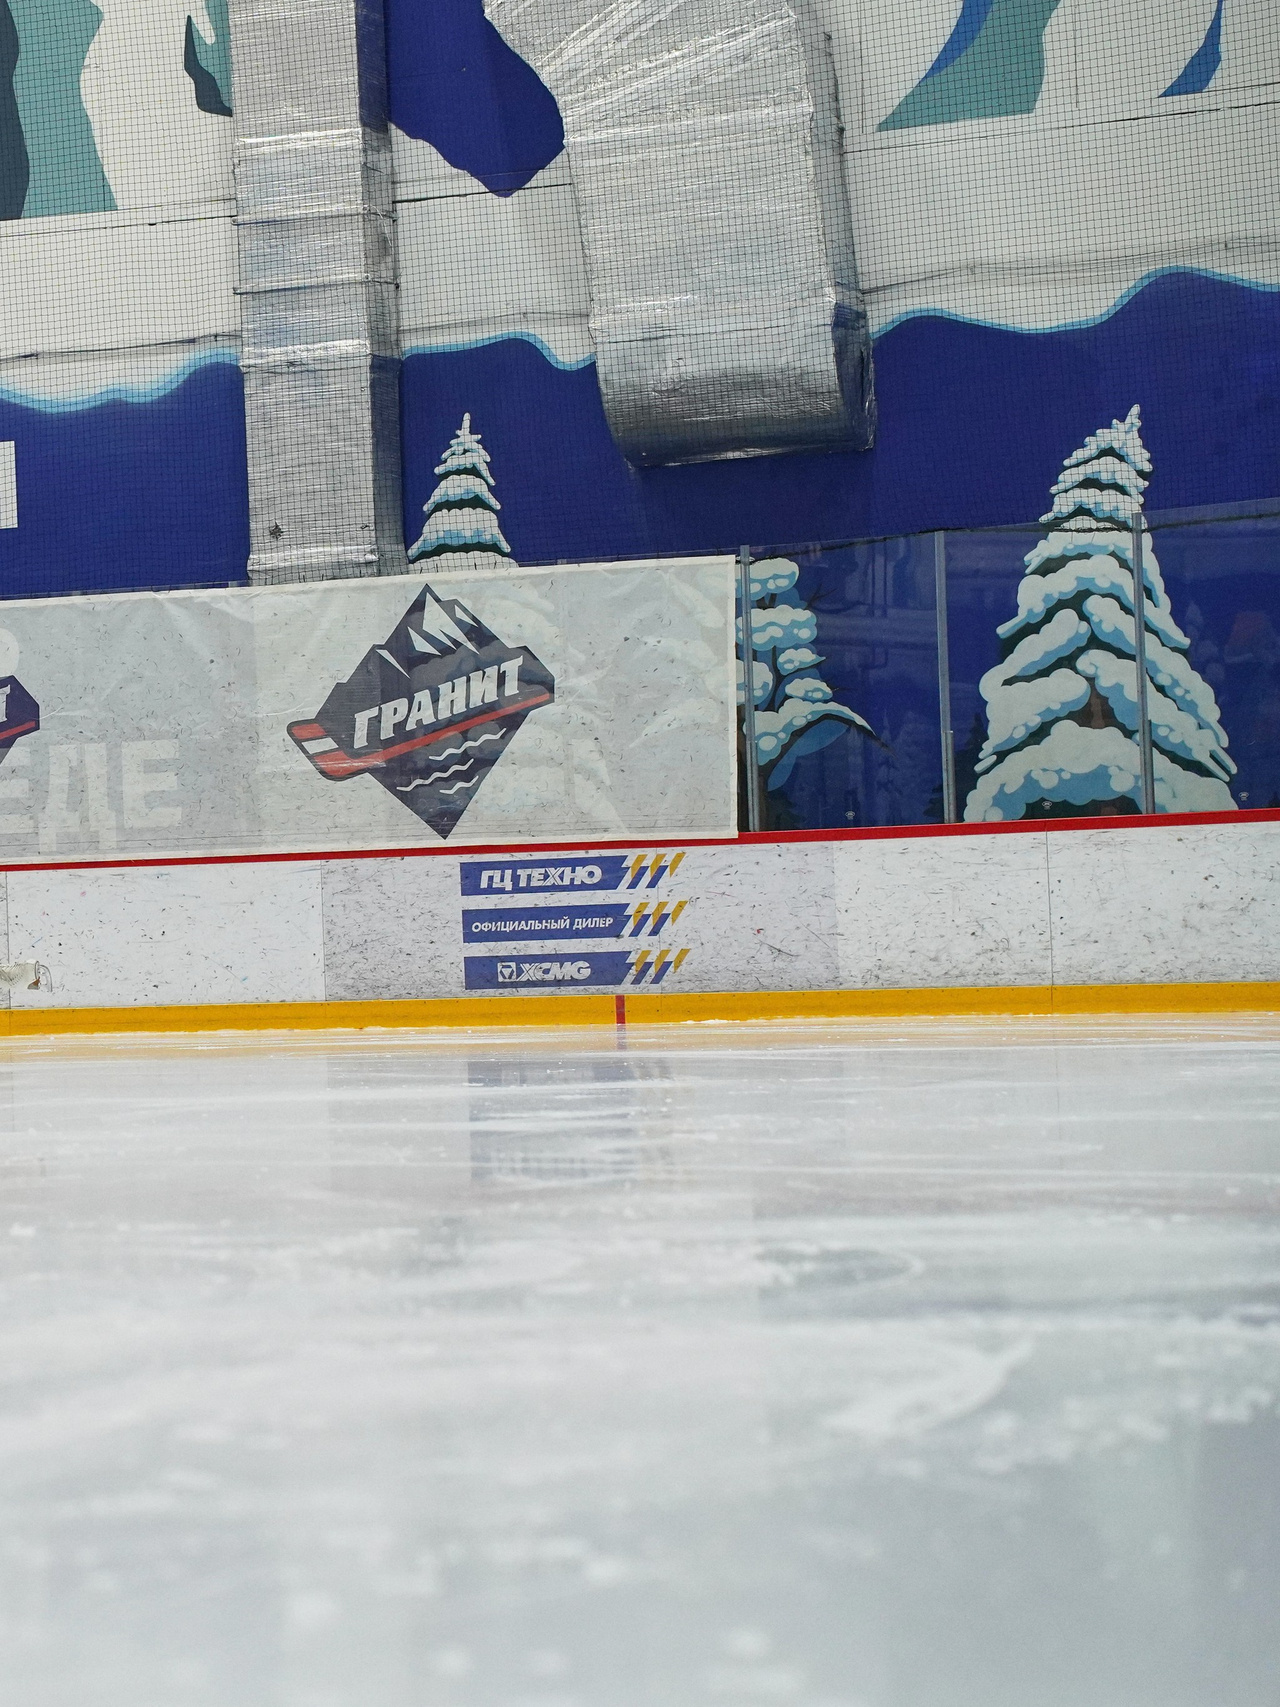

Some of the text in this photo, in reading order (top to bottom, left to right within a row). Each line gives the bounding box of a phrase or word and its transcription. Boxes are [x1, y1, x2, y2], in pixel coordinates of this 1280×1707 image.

[353, 655, 524, 749] ГРАНИТ
[480, 865, 602, 891] ГЦ ТЕХНО
[472, 916, 613, 933] ОФИЦИАЛЬНЫЙ ДИЛЕР
[516, 961, 591, 982] XCMG
